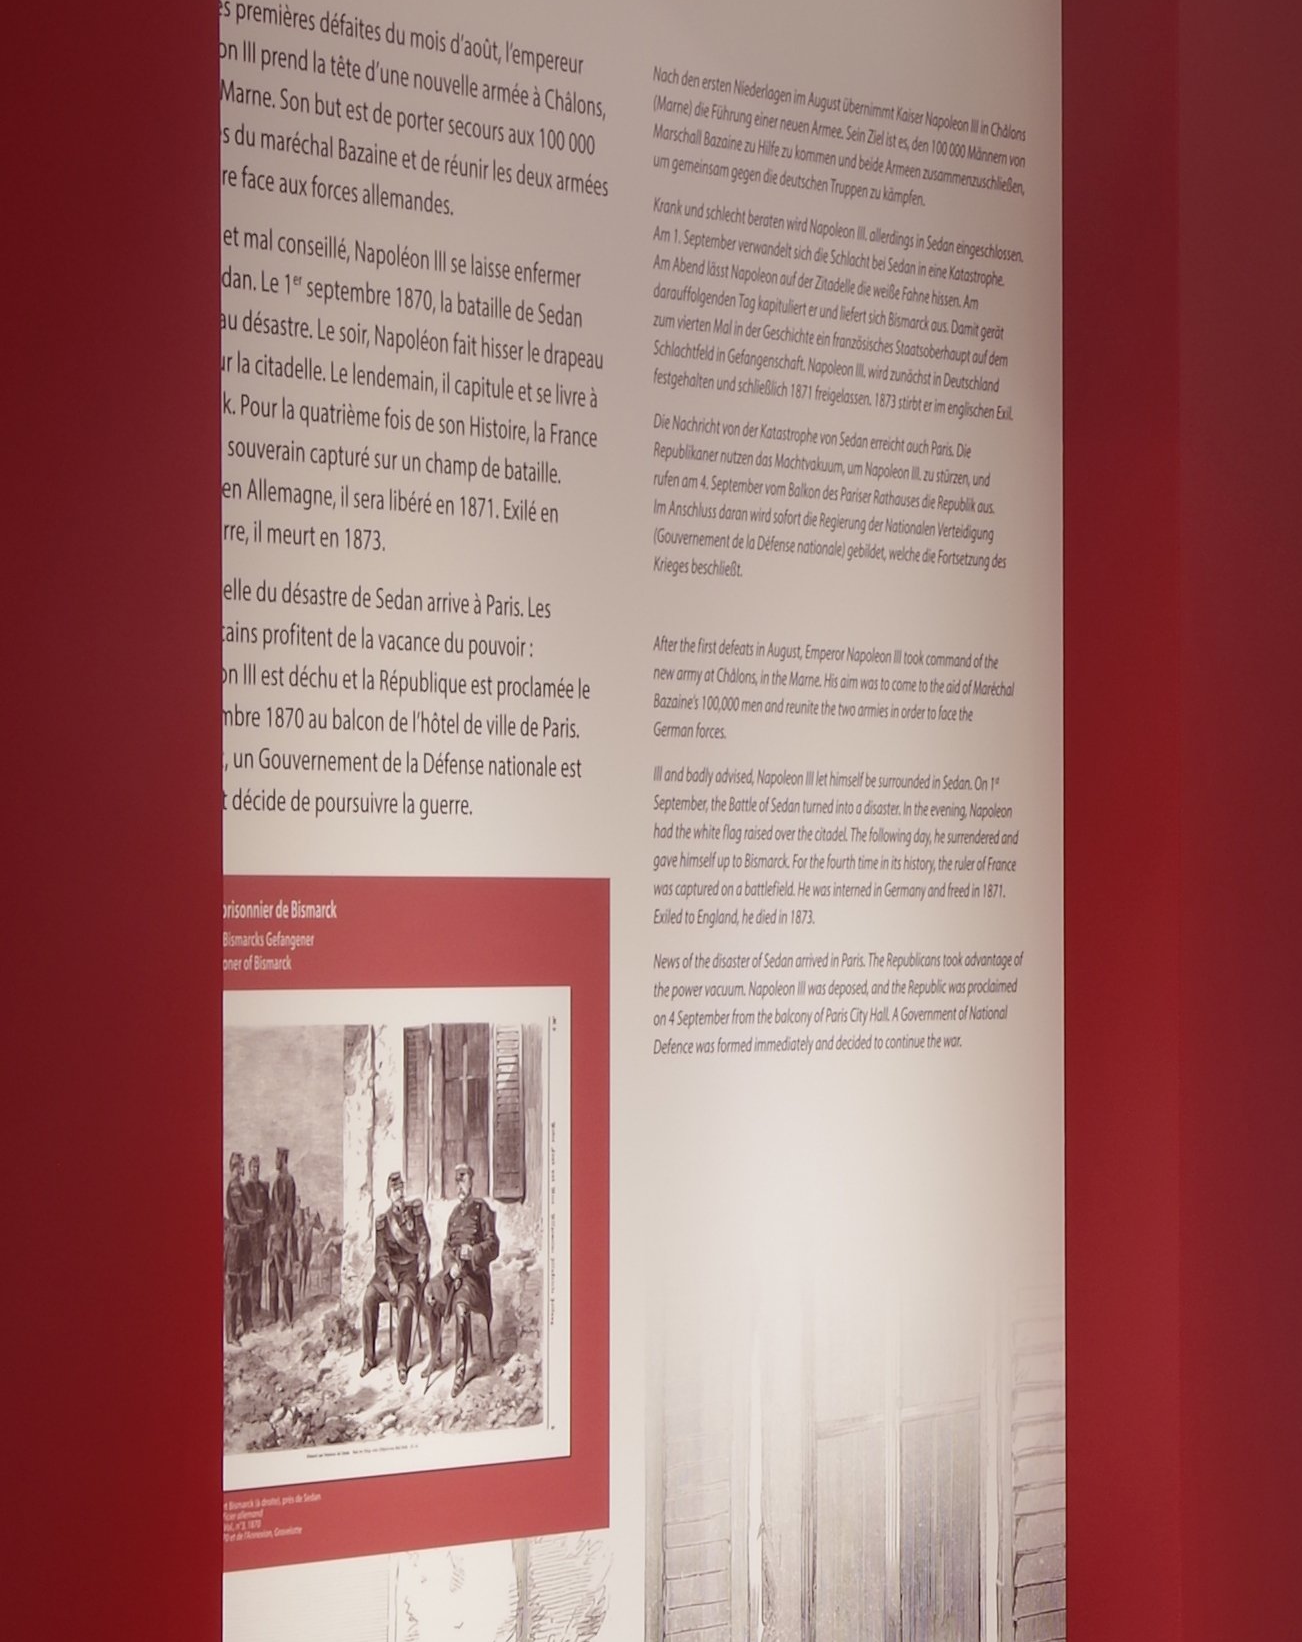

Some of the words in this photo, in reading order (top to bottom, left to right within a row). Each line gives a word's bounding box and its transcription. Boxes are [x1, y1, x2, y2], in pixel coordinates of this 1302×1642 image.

[235, 3, 316, 31] premières
[318, 12, 381, 42] défaites
[384, 22, 406, 45] du
[409, 30, 447, 52] mois
[242, 40, 256, 63] III
[260, 49, 309, 71] prend
[312, 51, 326, 74] la
[329, 55, 361, 80] tête
[412, 73, 479, 98] nouvelle
[481, 82, 529, 106] armée
[531, 85, 541, 107] à
[543, 88, 606, 120] Châlons,
[279, 88, 310, 113] Son
[314, 93, 342, 118] but
[345, 102, 369, 122] est
[371, 102, 393, 125] de
[395, 111, 445, 133] porter
[447, 119, 505, 142] secours
[507, 128, 535, 146] aux
[233, 124, 256, 147] du
[259, 132, 333, 158] maréchal
[337, 138, 398, 167] Bazaine
[401, 150, 417, 170] et
[420, 150, 441, 173] de
[443, 153, 490, 179] réunir
[492, 159, 513, 183] les
[515, 163, 553, 189] deux
[555, 173, 609, 196] armées
[240, 167, 275, 191] face
[278, 177, 308, 196] aux
[310, 176, 359, 203] forces
[361, 183, 454, 215] allemandes.
[223, 226, 239, 247] et
[243, 229, 273, 250] mal
[276, 236, 351, 263] conseillé,
[354, 239, 430, 270] Napoléon
[433, 249, 447, 272] III
[450, 257, 467, 274] se
[470, 253, 511, 280] laisse
[513, 261, 581, 288] enfermer
[226, 440, 305, 462] souverain
[309, 446, 370, 470] capturé
[373, 453, 398, 470] sur
[401, 455, 421, 472] un
[424, 451, 478, 482] champ
[480, 456, 501, 479] de
[503, 457, 561, 484] bataille.
[253, 521, 262, 542] il
[266, 526, 316, 546] meurt
[319, 531, 339, 547] en
[344, 528, 386, 551] 1873.
[653, 556, 689, 575] Krieges
[255, 581, 277, 602] du
[281, 582, 348, 607] désastre
[351, 586, 372, 608] de
[375, 587, 423, 611] Sedan
[426, 592, 470, 613] arrive
[472, 592, 482, 614] à
[485, 594, 524, 617] Paris.
[527, 596, 551, 618] Les
[654, 722, 693, 739] German
[231, 788, 287, 811] décide
[289, 789, 311, 812] de
[314, 792, 399, 818] poursuivre
[402, 791, 415, 813] la
[418, 798, 473, 820] guerre.
[275, 899, 289, 918] de
[291, 899, 337, 919] Bismarck
[266, 931, 314, 951] Gefangener
[254, 955, 292, 970] Bismarck
